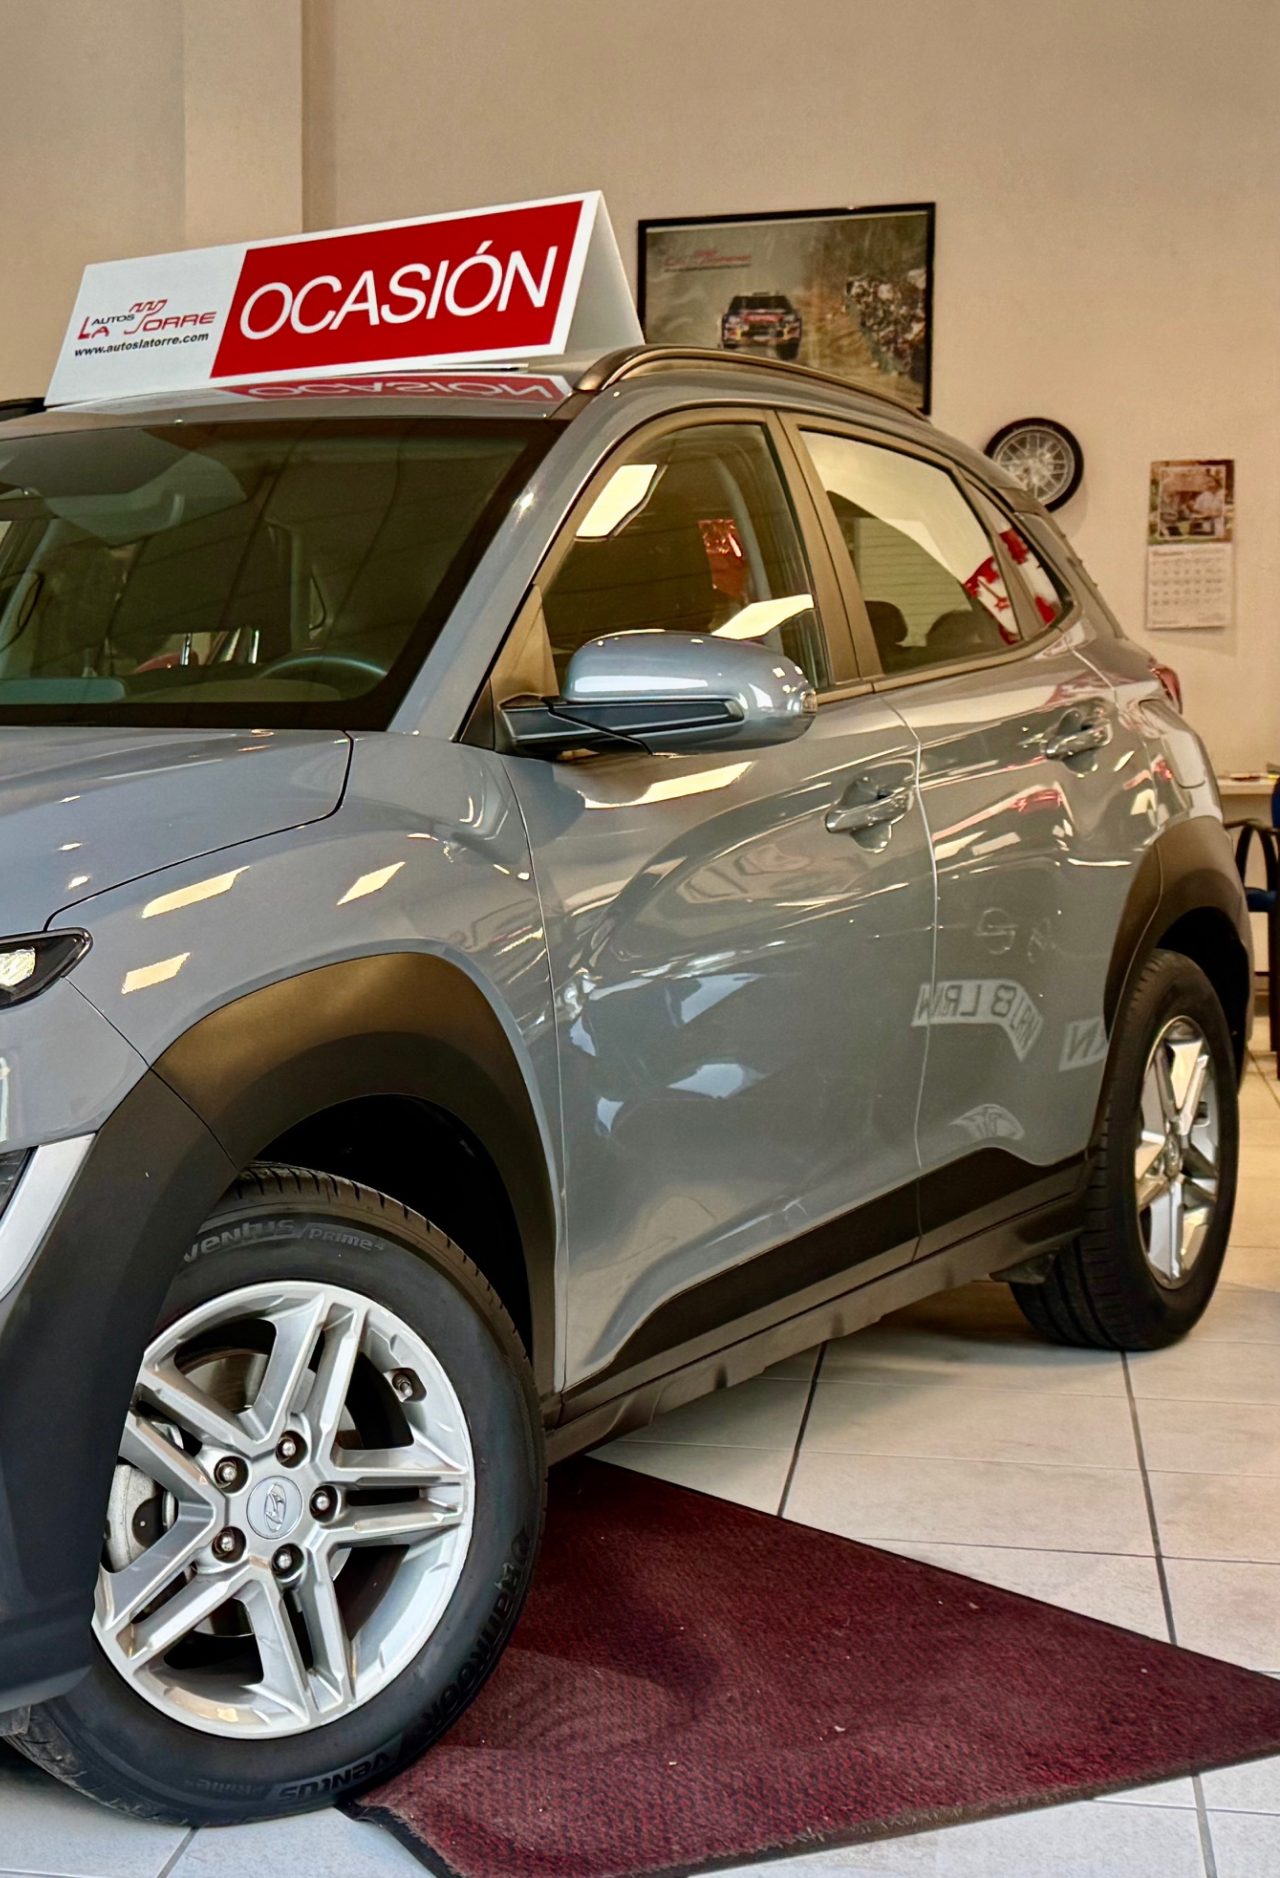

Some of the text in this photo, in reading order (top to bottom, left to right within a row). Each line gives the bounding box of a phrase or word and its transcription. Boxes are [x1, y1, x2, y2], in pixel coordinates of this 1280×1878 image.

[240, 240, 559, 340] OCASIÓN
[77, 316, 110, 340] LA
[91, 313, 135, 326] AUTOS
[74, 332, 209, 357] www.autoslatorre.com
